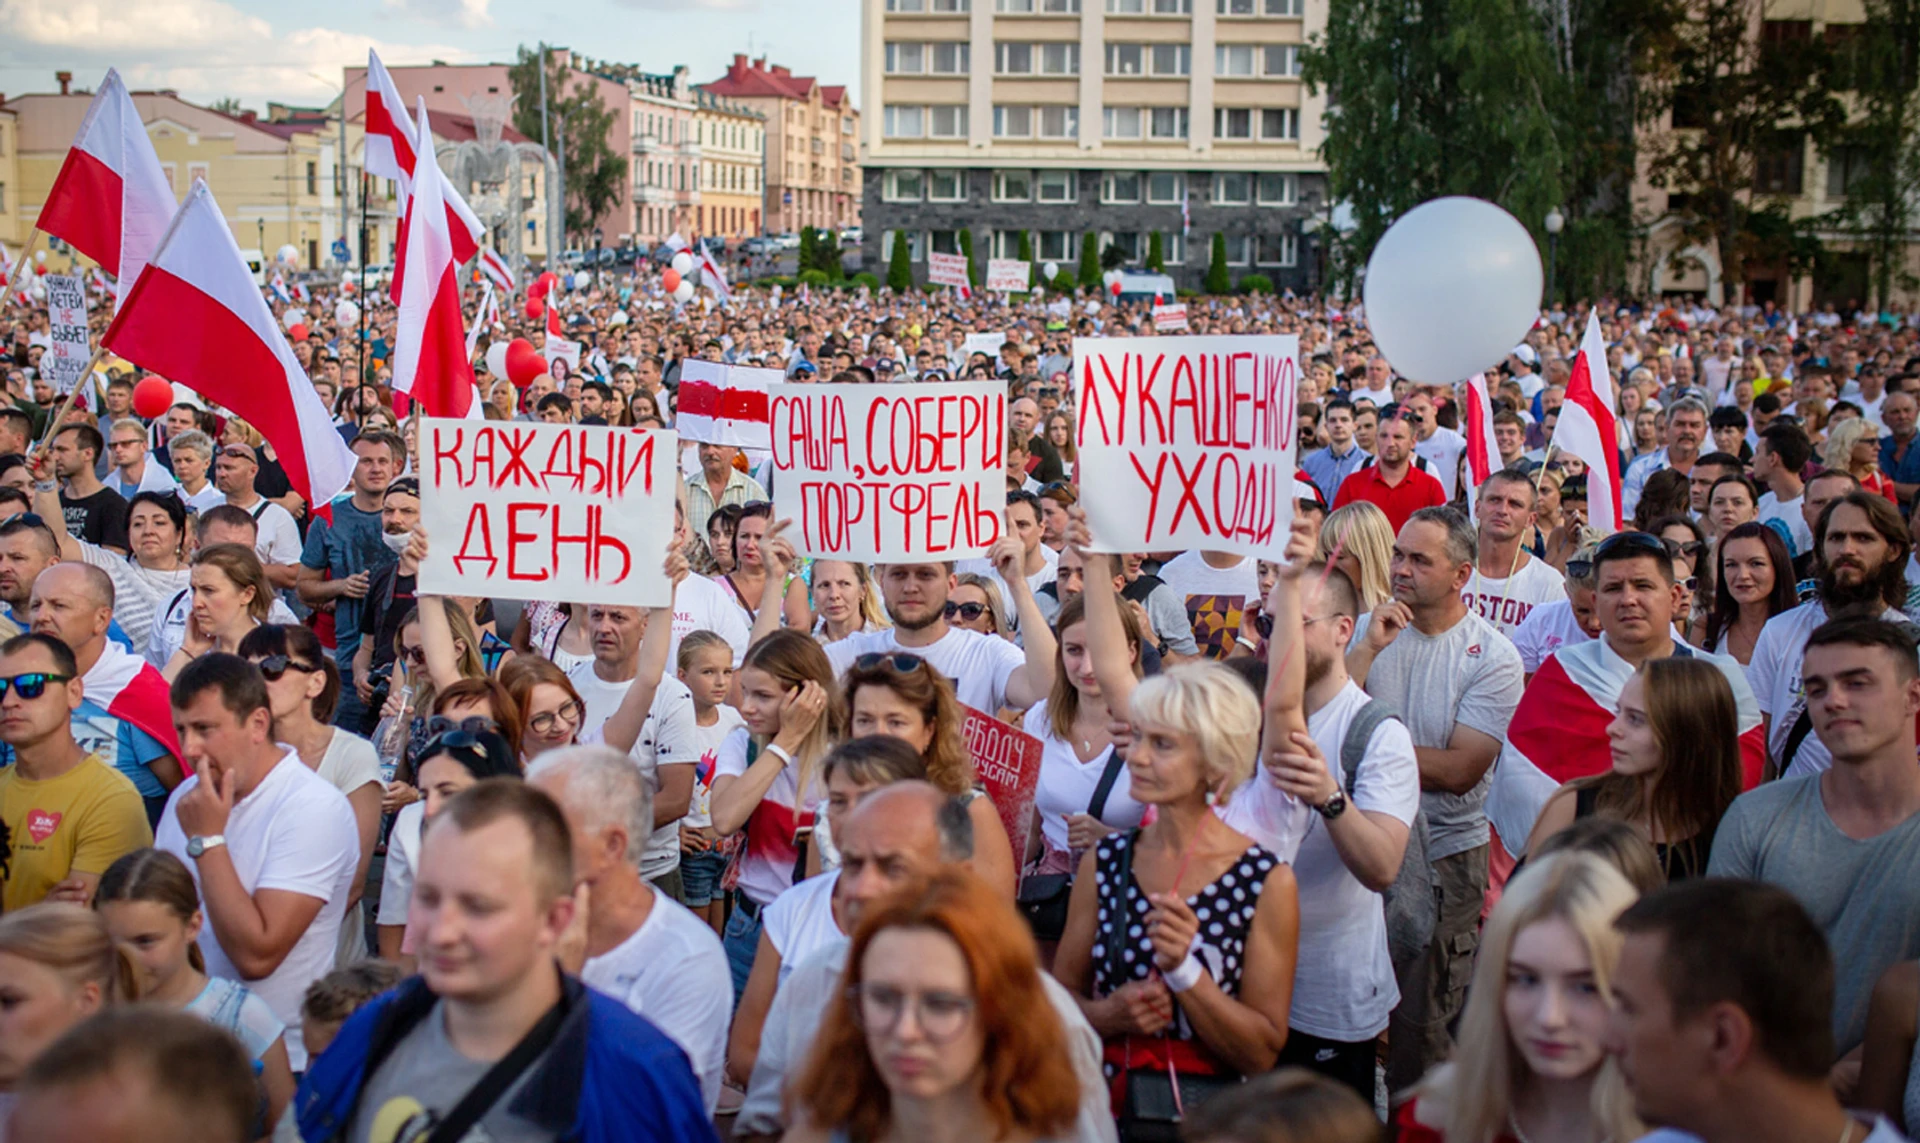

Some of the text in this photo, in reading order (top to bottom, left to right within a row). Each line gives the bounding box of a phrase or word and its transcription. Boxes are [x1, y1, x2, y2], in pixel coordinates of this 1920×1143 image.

[50, 292, 84, 310] ДЕТЕЙ
[60, 308, 75, 325] НЕ
[1078, 352, 1293, 451] ЛУКАШЕНКО
[434, 427, 654, 500] КАЖДЫЙ
[771, 393, 1004, 481] САША, СОБЕРИ
[800, 481, 1000, 554] ПОРТФЕЛЬ
[1129, 452, 1276, 546] УХОДИ
[453, 502, 631, 584] ДЕНЬ
[673, 611, 695, 623] ME,
[1462, 593, 1534, 627] OSTON
[963, 716, 1026, 774] АБОДУ
[971, 755, 1019, 790] РУСАМ
